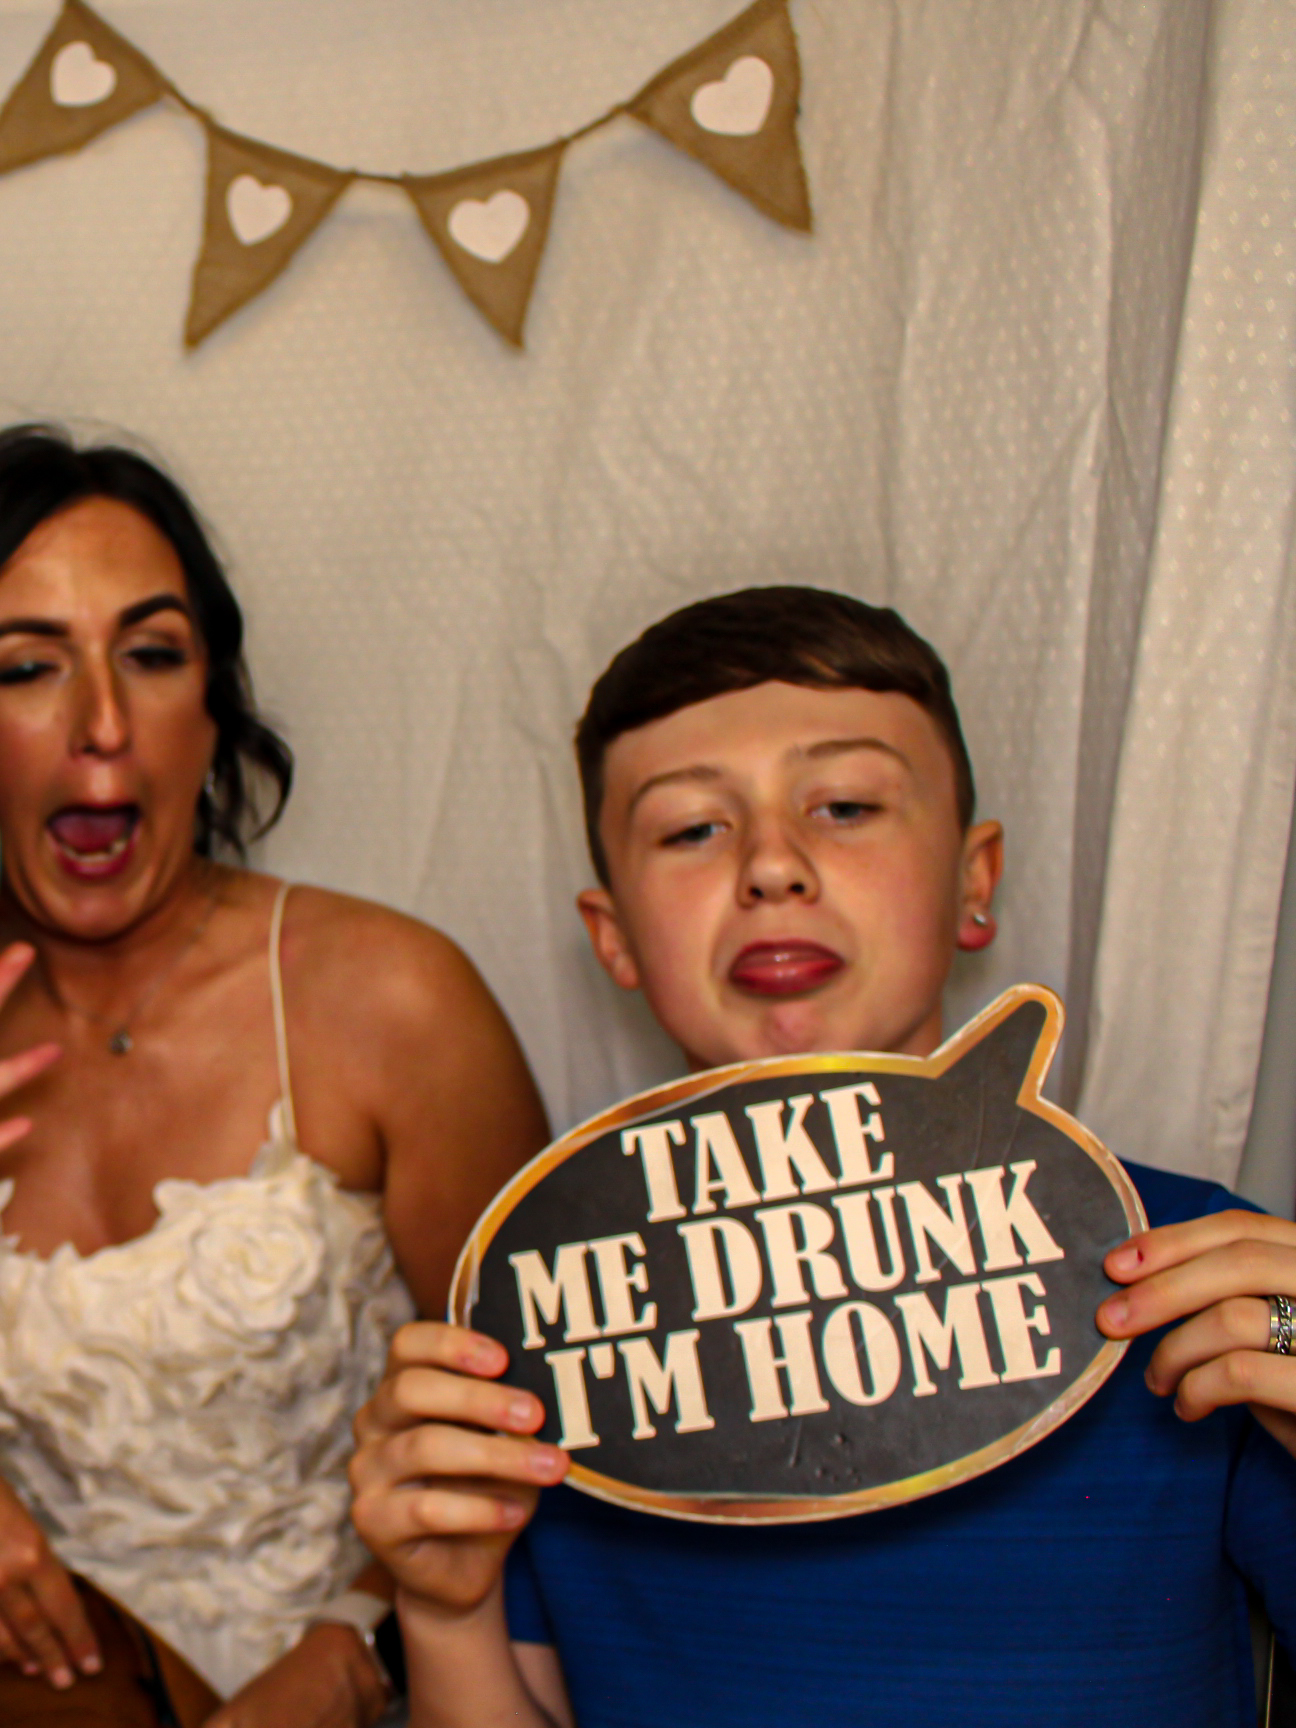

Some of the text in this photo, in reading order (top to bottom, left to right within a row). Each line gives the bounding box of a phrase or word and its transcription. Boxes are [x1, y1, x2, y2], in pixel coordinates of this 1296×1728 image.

[621, 1082, 895, 1223] TAKE
[508, 1159, 1065, 1350] ME DRUNK
[544, 1272, 1062, 1451] I'M HOME
